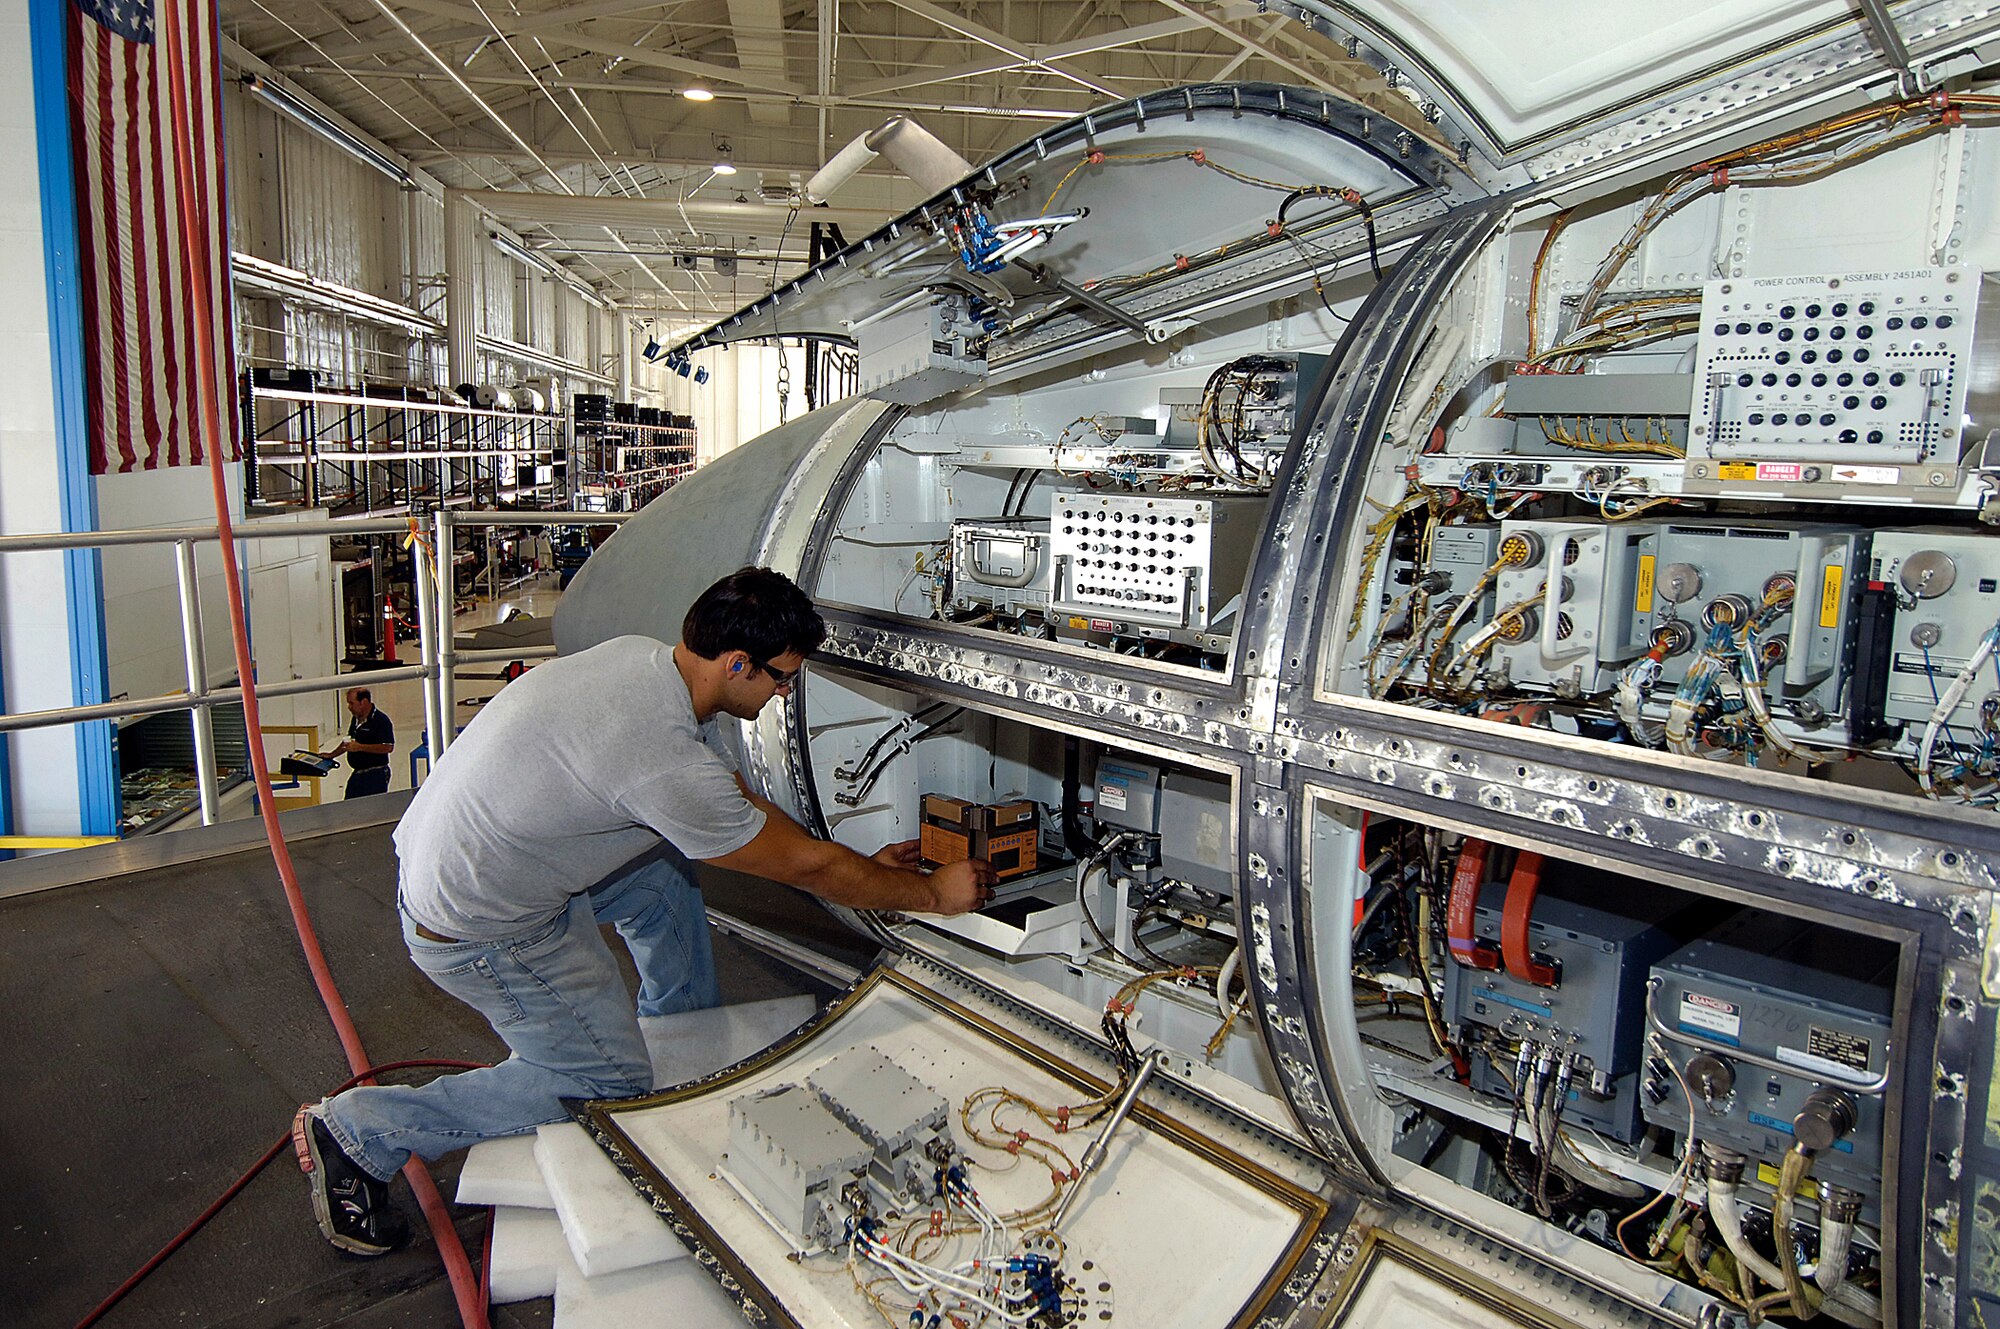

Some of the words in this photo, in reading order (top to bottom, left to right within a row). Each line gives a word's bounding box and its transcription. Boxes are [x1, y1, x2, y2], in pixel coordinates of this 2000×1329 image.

[1754, 279, 1783, 287] POWER
[1786, 276, 1826, 286] CONTROL
[1843, 273, 1890, 282] ASSEMBLY
[1893, 270, 1932, 280] 2451A01
[1765, 465, 1796, 473] DANGER
[1691, 994, 1728, 1012] DANGER
